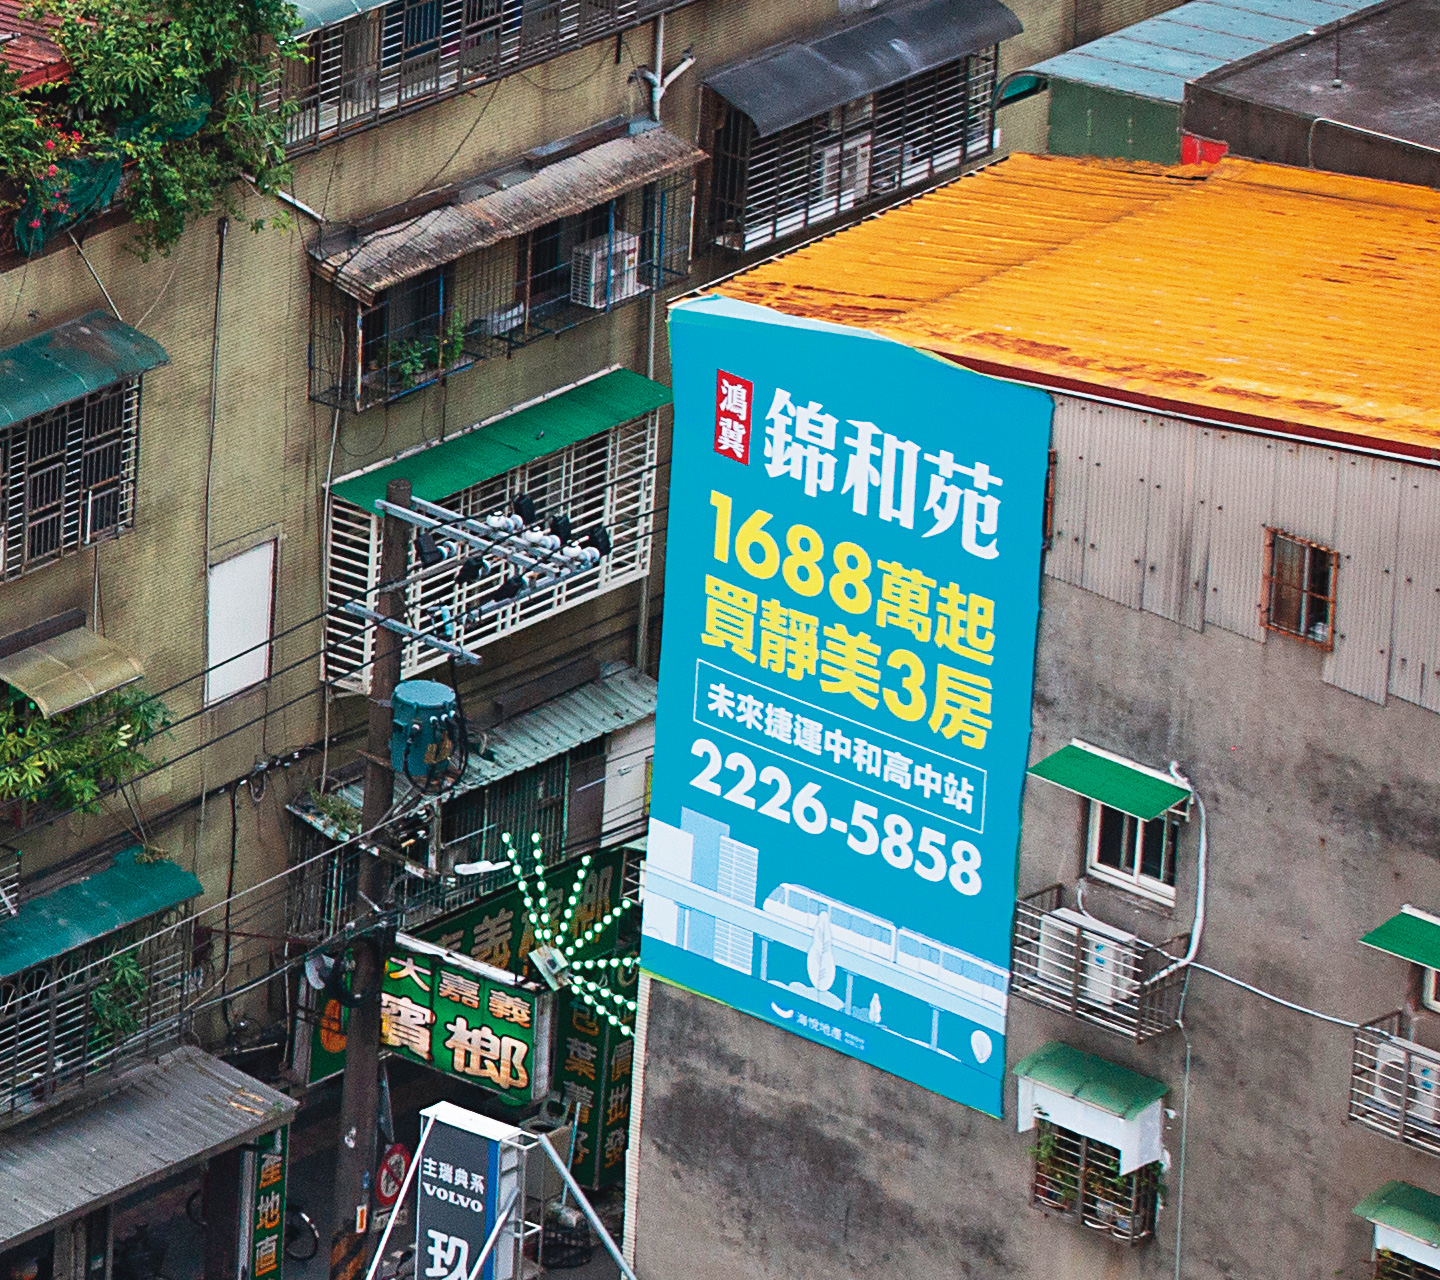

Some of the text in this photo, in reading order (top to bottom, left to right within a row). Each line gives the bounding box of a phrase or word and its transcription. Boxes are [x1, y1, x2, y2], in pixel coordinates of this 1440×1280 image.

[762, 388, 1004, 560] 錦和苑
[709, 489, 996, 667] 1688萬起
[700, 573, 994, 751] 買靜美3房
[690, 738, 983, 897] 2226-5858
[707, 682, 975, 816] 未來捷運中和高中站
[388, 956, 531, 1028] 大嘉義
[422, 1182, 483, 1213] VOLVO
[423, 1157, 484, 1195] 主瑞典系
